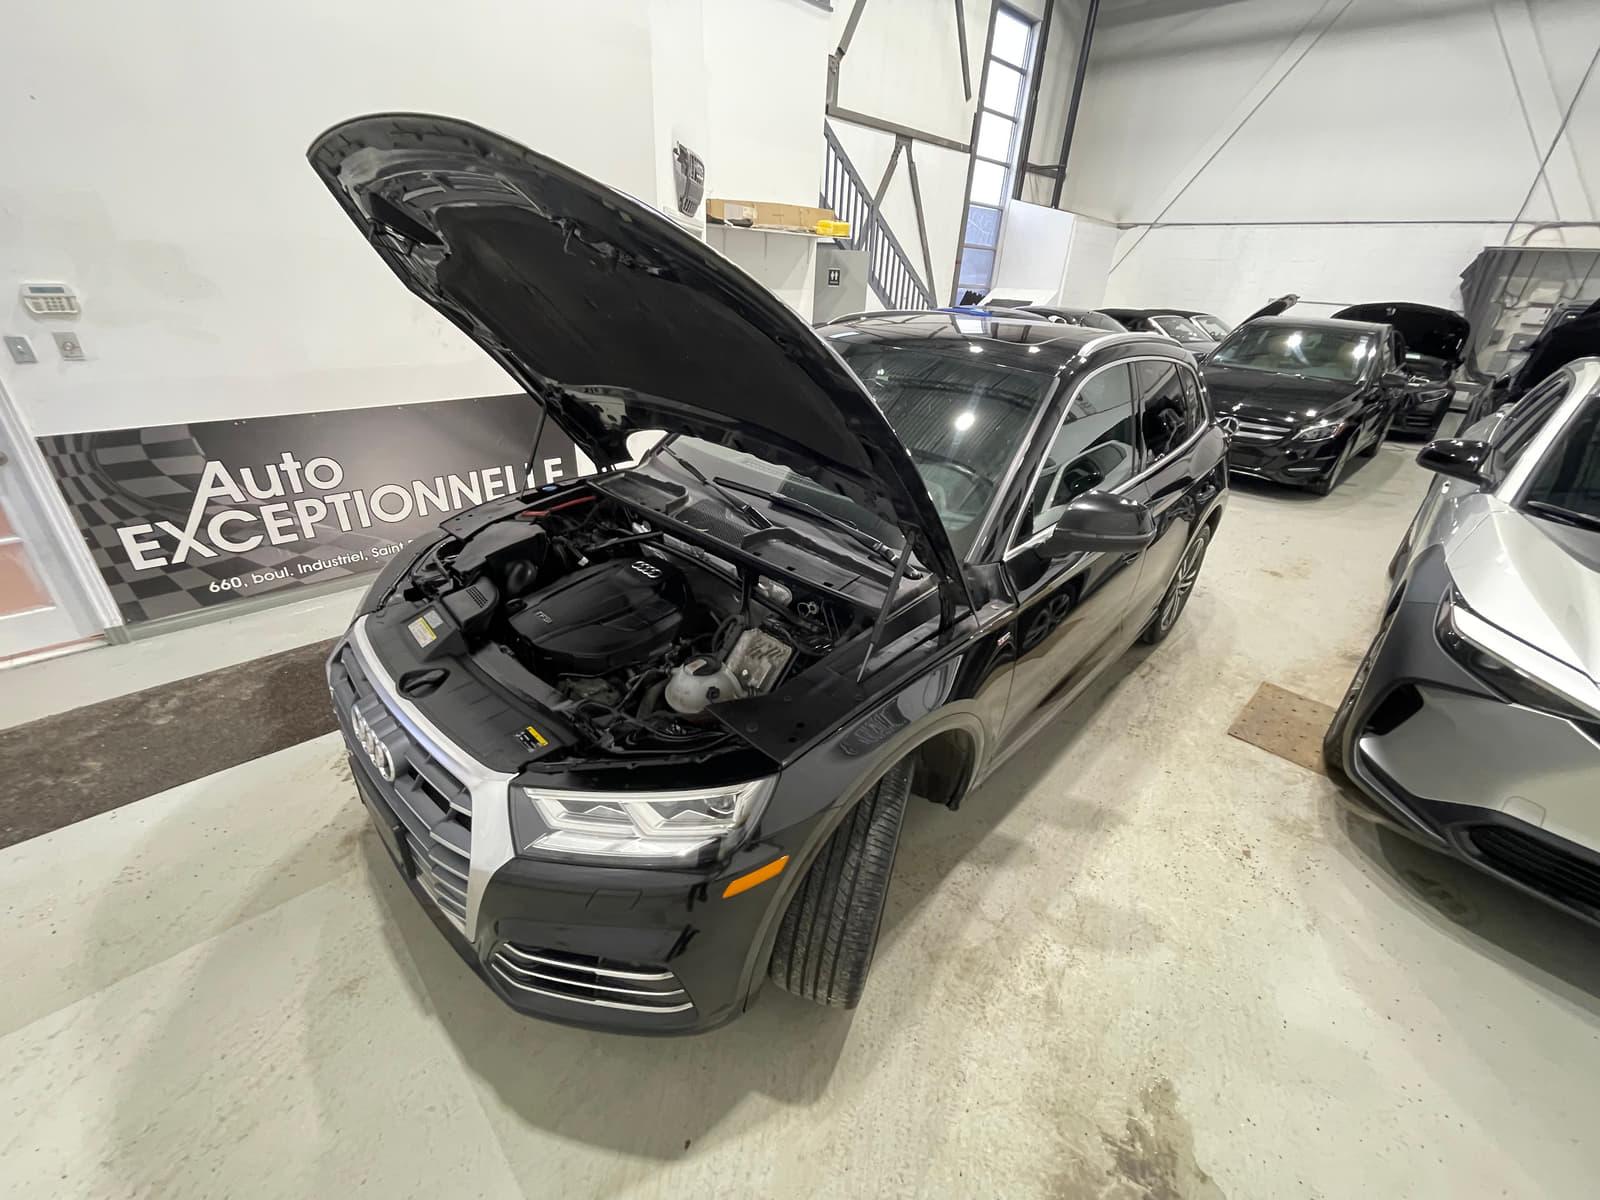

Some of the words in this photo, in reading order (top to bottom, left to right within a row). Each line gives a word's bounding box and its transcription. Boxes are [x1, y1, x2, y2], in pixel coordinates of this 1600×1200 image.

[204, 452, 343, 502] Auto
[209, 575, 248, 593] 660,
[252, 567, 294, 584] boul.
